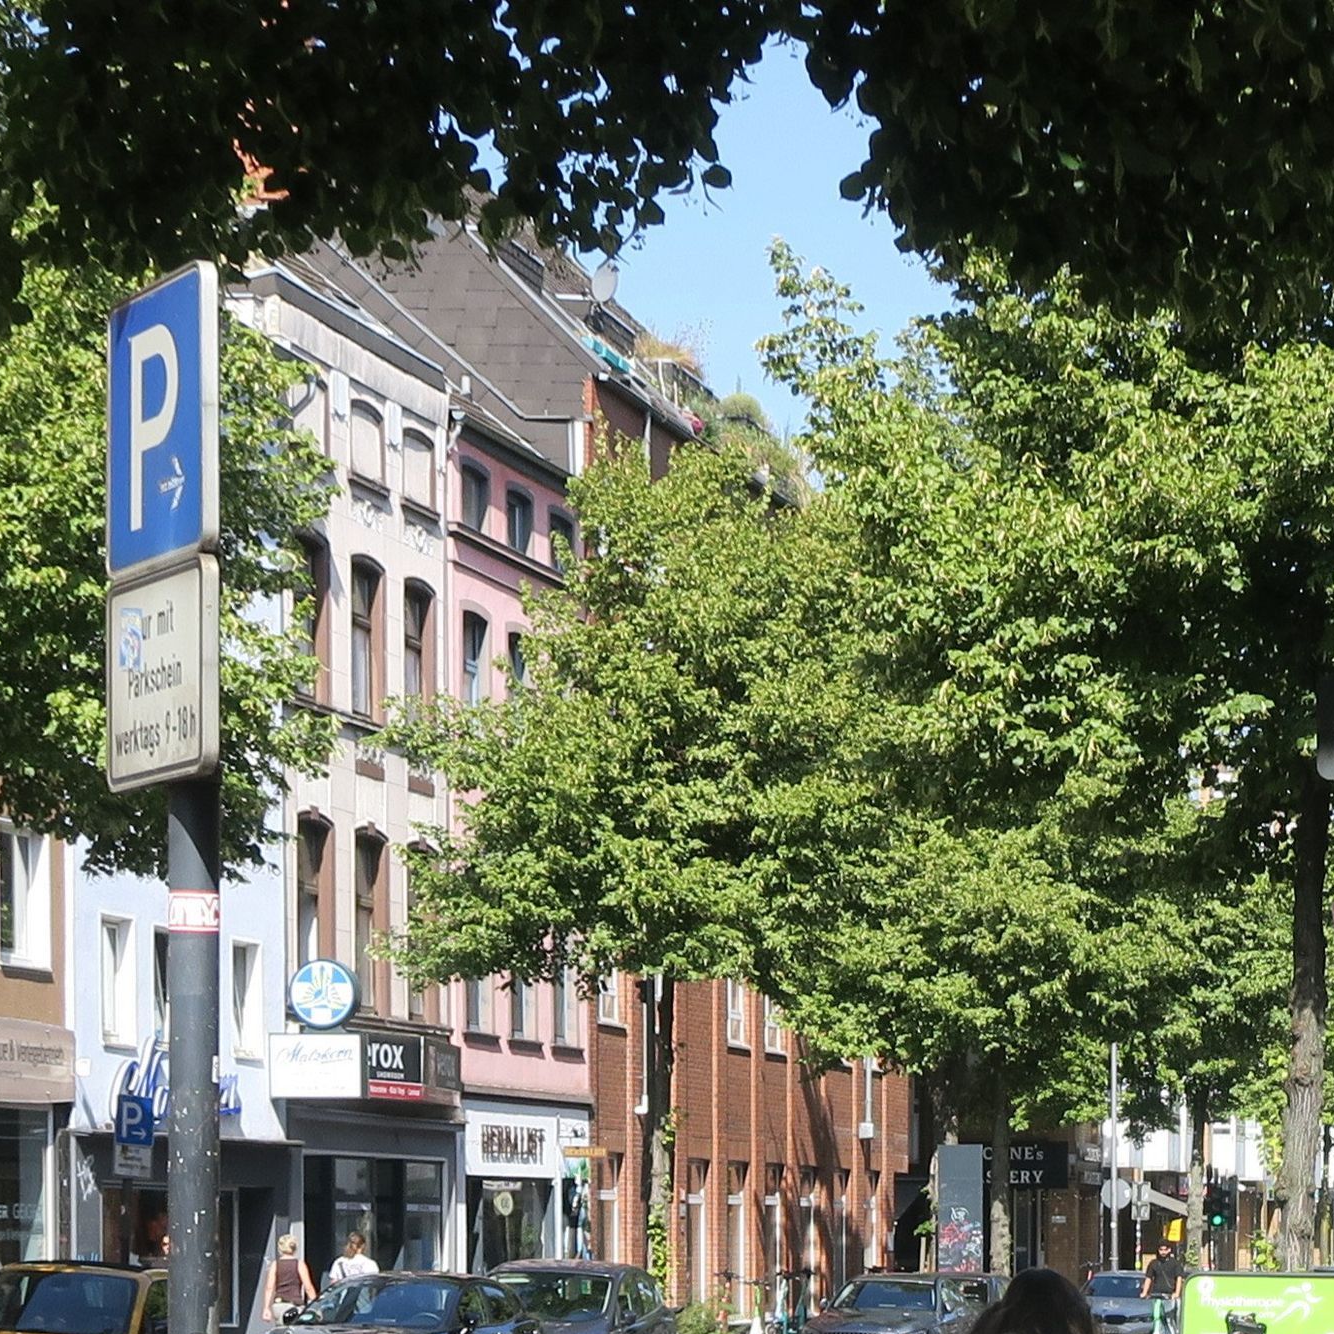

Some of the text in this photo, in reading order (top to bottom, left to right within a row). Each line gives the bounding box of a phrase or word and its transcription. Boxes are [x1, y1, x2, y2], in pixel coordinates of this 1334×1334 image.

[128, 323, 179, 532] P
[157, 599, 174, 636] mit
[128, 654, 182, 700] Parkschein
[116, 719, 160, 757] werktags
[122, 1101, 142, 1138] P
